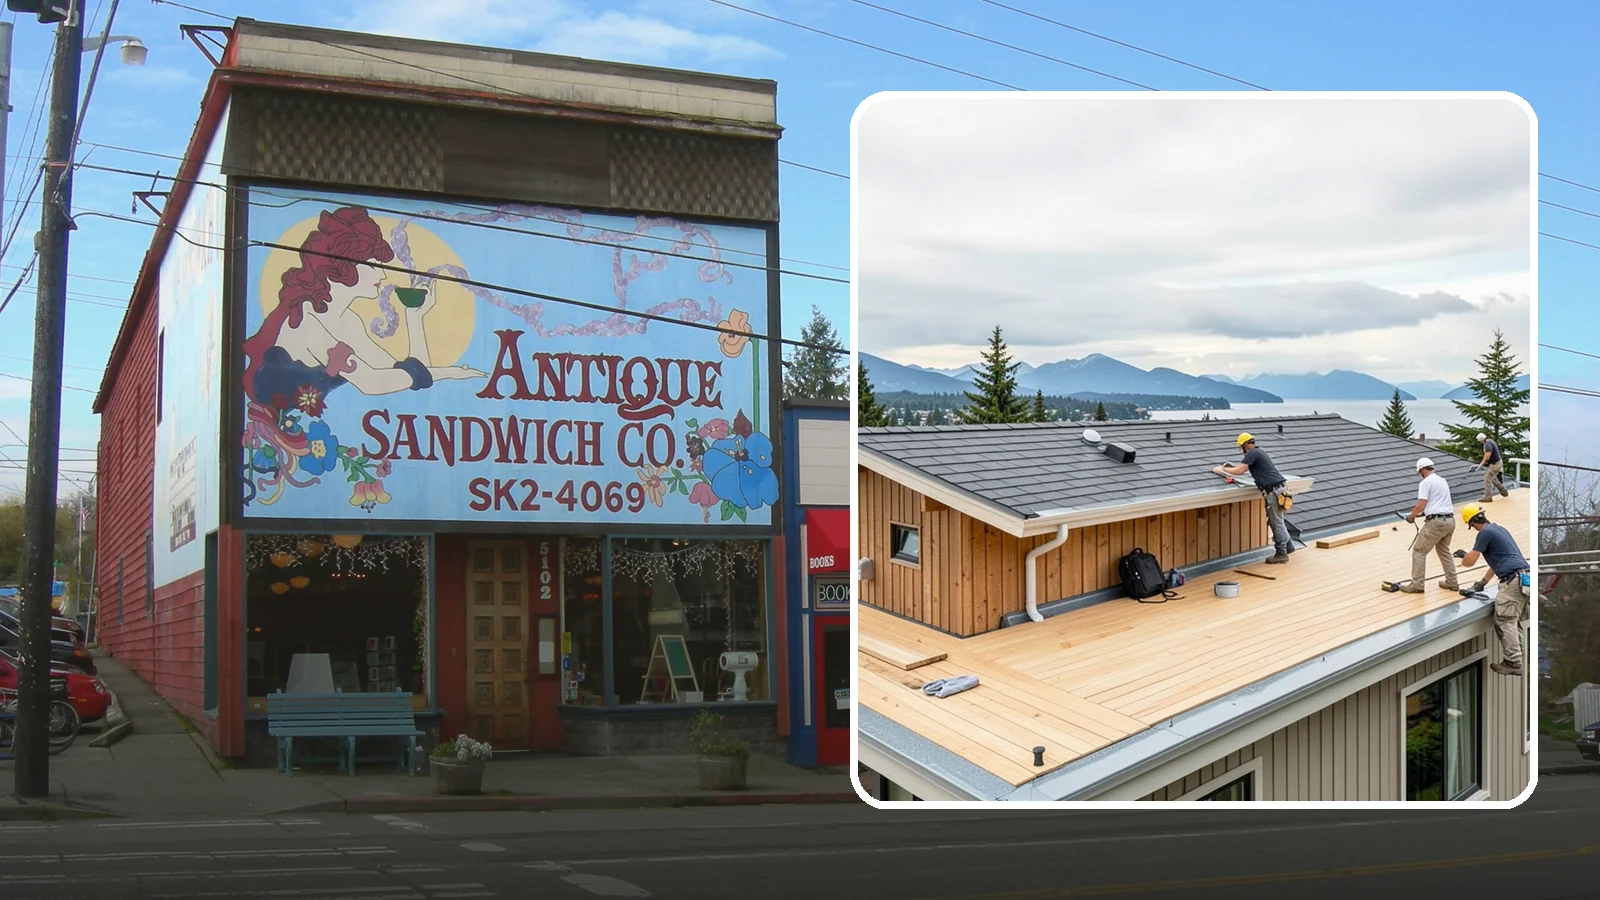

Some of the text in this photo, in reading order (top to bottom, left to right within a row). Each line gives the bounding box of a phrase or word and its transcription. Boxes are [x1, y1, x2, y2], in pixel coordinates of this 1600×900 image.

[476, 329, 723, 420] ANTIQUE
[362, 409, 685, 469] SANDWICH CO.
[469, 477, 646, 513] SK2-4069
[540, 541, 552, 600] 5102
[809, 555, 835, 569] BOOKS
